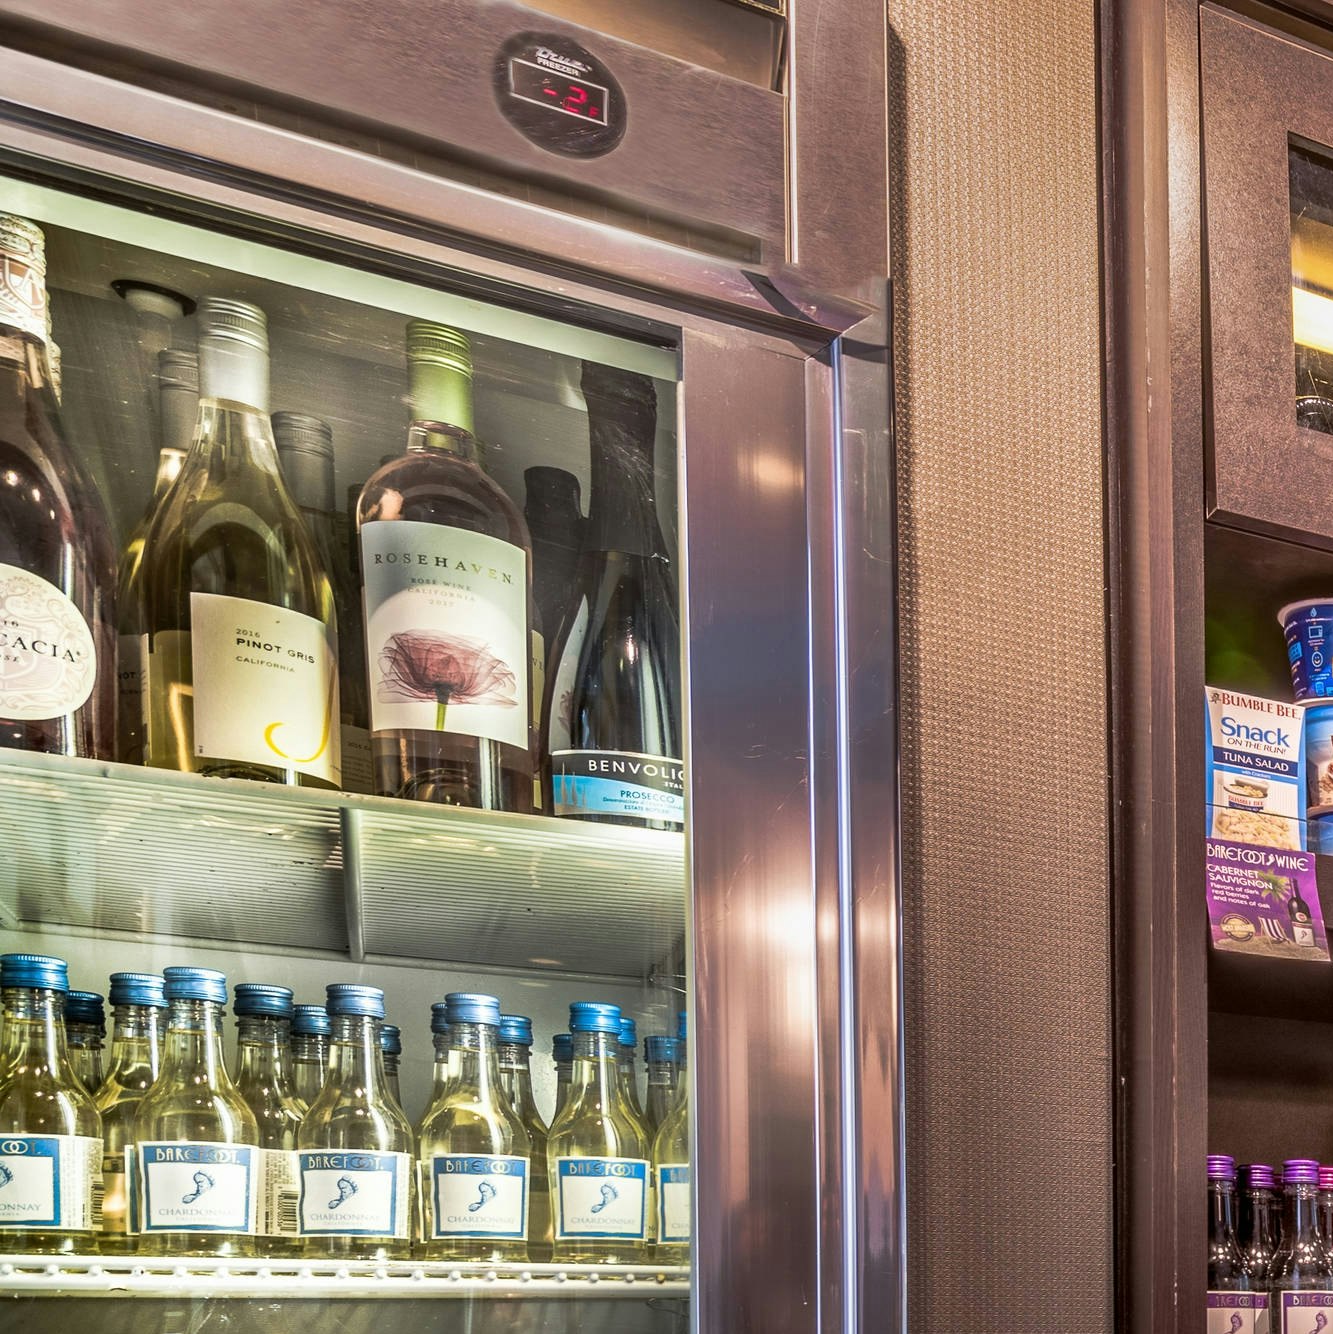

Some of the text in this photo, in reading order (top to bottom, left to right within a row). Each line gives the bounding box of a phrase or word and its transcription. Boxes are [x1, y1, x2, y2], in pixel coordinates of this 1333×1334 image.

[374, 553, 513, 585] ROSEHAVEN
[236, 638, 316, 664] PINOT GRIS
[236, 656, 295, 672] CALIFORNIA
[1222, 692, 1298, 719] BUMBLE BEE
[1220, 716, 1291, 748] Snack
[1227, 738, 1242, 746] ON
[1245, 740, 1260, 750] THE
[1223, 751, 1289, 772] TUNA SALAD
[1206, 843, 1309, 872] BAREFOOT WINE
[1207, 863, 1259, 879] CABERNET
[1208, 872, 1273, 890] SAUVIGNON
